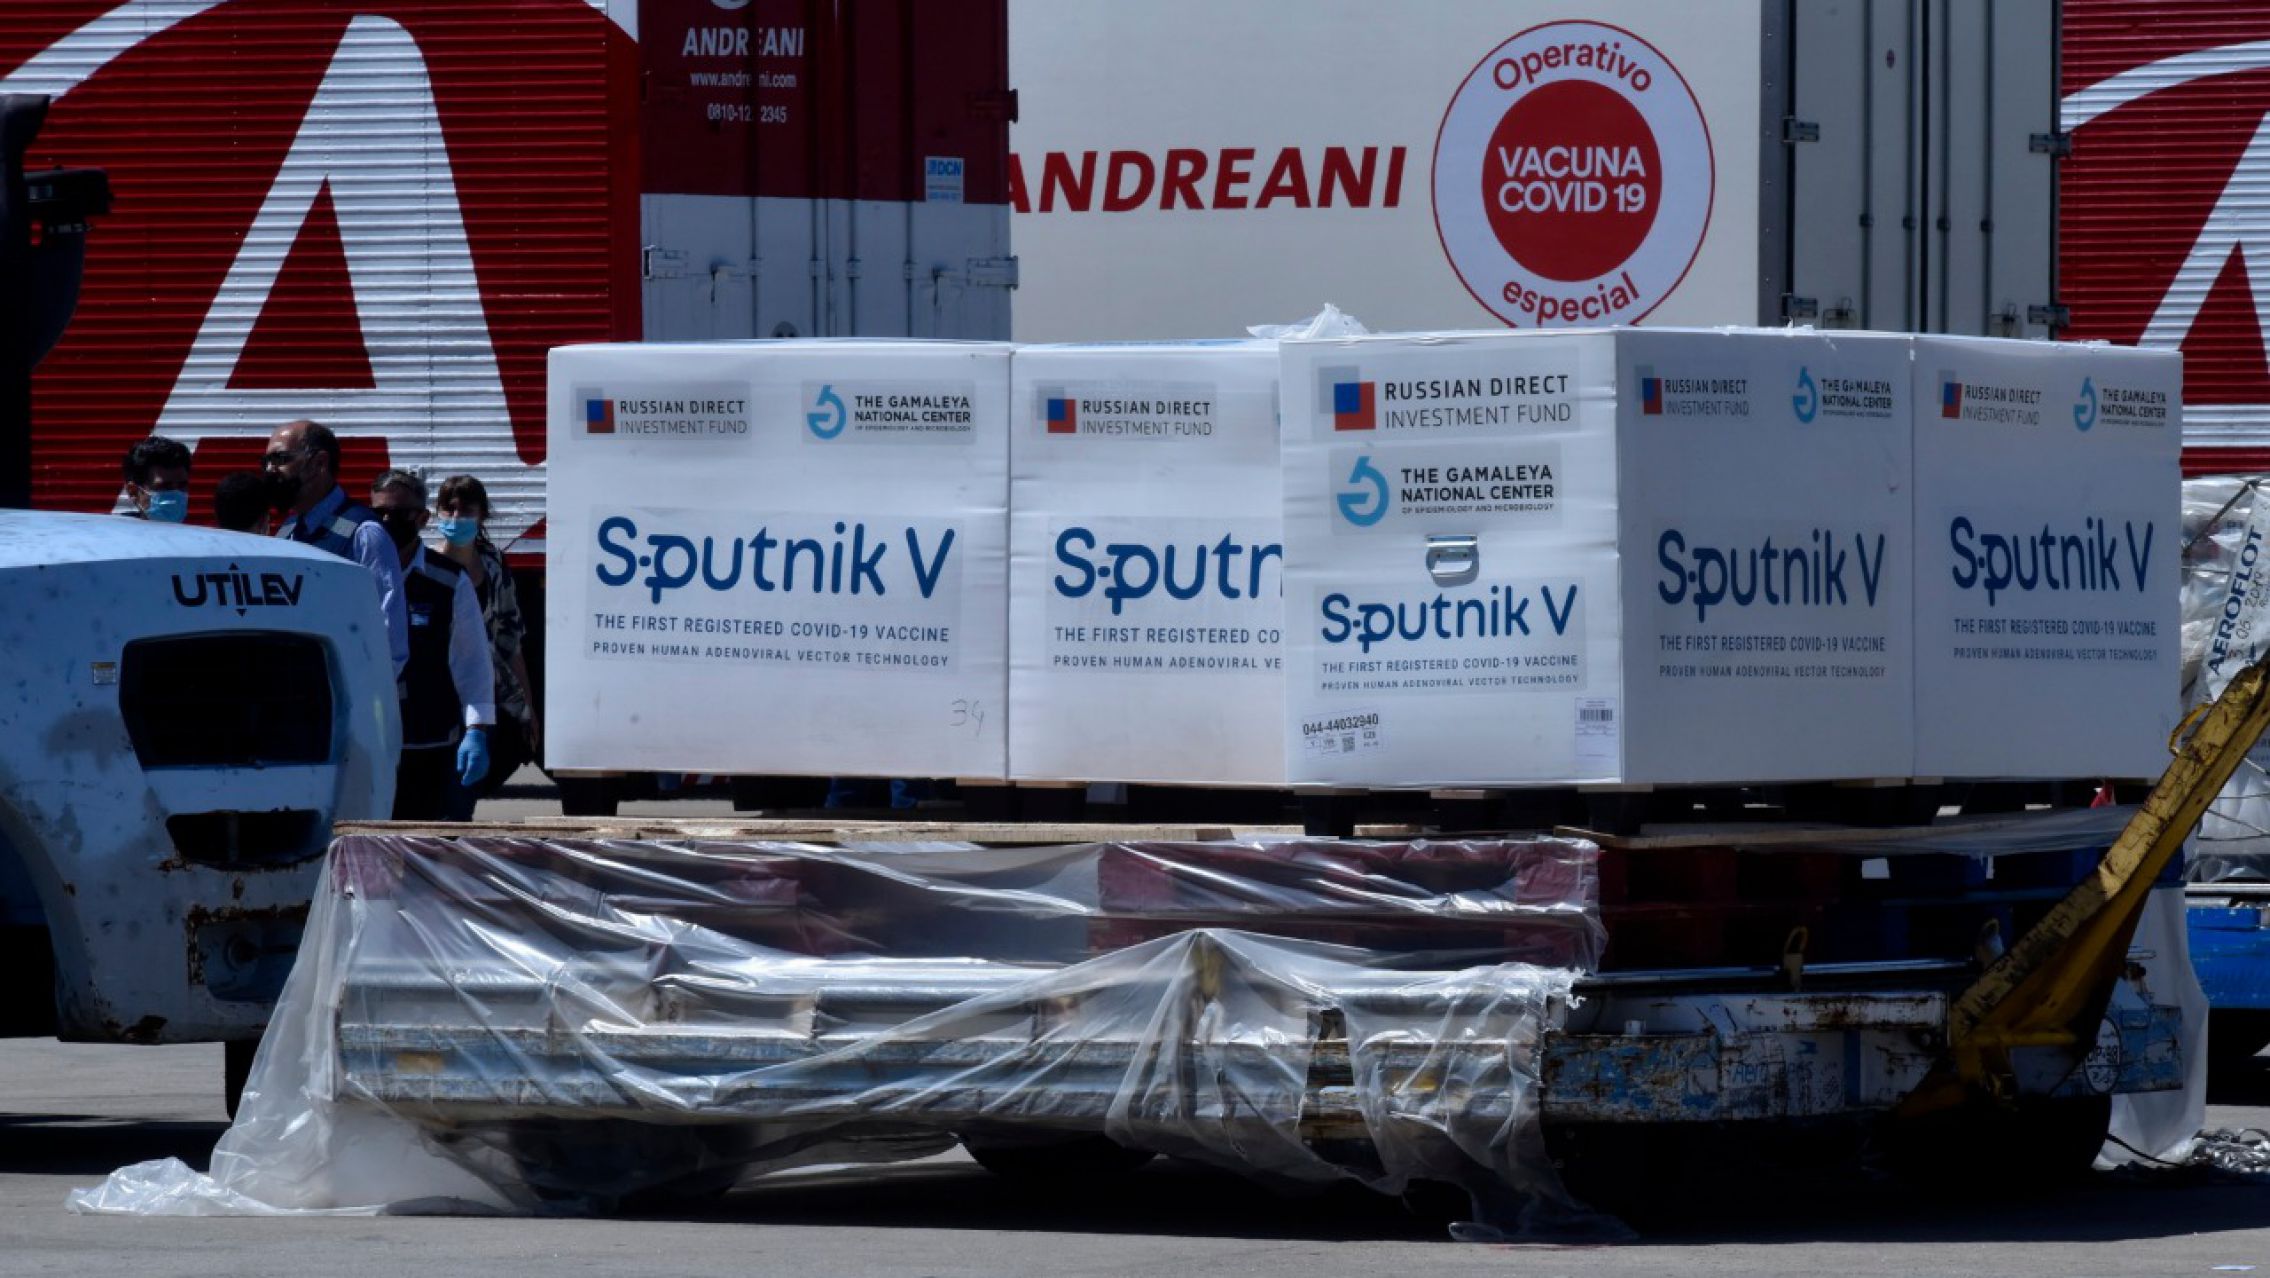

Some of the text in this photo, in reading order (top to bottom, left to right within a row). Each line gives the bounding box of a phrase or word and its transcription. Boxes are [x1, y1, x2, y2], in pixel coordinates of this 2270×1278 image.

[682, 27, 805, 57] ANDRANI
[1493, 41, 1653, 93] Operativo
[690, 70, 797, 88] www.andreni.com
[1499, 146, 1645, 179] VACUNA
[1498, 181, 1645, 214] COVID 19
[1502, 271, 1640, 327] especial
[1384, 374, 1569, 400] RUSSIAN DIRECT
[1664, 379, 1747, 395] RUSSIAN DIRECT
[1821, 378, 1839, 392] THE
[854, 395, 970, 409] THE GAMALEYA
[1965, 385, 2042, 405] RUSSIAN DIRECT
[620, 400, 745, 414] RUSSIAN DIRECT
[1082, 400, 1211, 416] RUSSIAN DIRECT
[1384, 402, 1571, 429] INVESTMENT FUND
[1664, 400, 1750, 416] INVESTMENT FUND
[854, 410, 971, 424] NATIONAL CENTER
[620, 419, 748, 435] INVESTMENT FUND
[1082, 420, 1213, 437] INVESTMENT FUND
[1401, 465, 1553, 484] THE GAMALEYA
[1401, 484, 1554, 503] NATIONAL CENTER
[595, 516, 955, 605] Sputnik V
[1950, 516, 2154, 607] Sputnik V
[1657, 528, 1886, 623] Sputnik V
[172, 572, 304, 609] UTILEV
[2208, 525, 2262, 675] AEROFLOT
[595, 614, 950, 642] THE FIRST REGISTERED COVID-19 VACCINE
[1322, 584, 1578, 653] Sputnik V
[1954, 618, 2157, 636] THE FIRST REGISTERED COVID-19 VACCINE
[1054, 626, 1086, 642] THE
[1092, 627, 1140, 642] FIRST
[1146, 628, 1249, 643] REGISTERED
[1660, 635, 1886, 652] THE FIRST REGISTERED COVID-19 VACCINE
[593, 642, 949, 667] PROVEN HUMAN ADENOVIRAL VECTOR TECHNOLOGY
[1053, 654, 1107, 667] PROVEN
[1113, 655, 1163, 668] HUMAN
[1168, 656, 1259, 669] ADENOVIRAL
[1322, 654, 1578, 673] THE FIRST REGISTERED COVID-19 VACCINE
[1953, 647, 1989, 659] PROVEN
[1991, 647, 2021, 659] HUMAN
[2077, 649, 2106, 660] VECTOR
[2109, 649, 2158, 661] TECHNOLOGY
[1659, 665, 1886, 677] PROVEN HUMAN ADENOVIRAL VECTOR TECHNOLOGY
[1320, 681, 1360, 690] PROVEN
[1363, 680, 1399, 689] HUMAN
[1468, 676, 1507, 686] VECTOR
[1510, 674, 1579, 685] TECHNOLOGY
